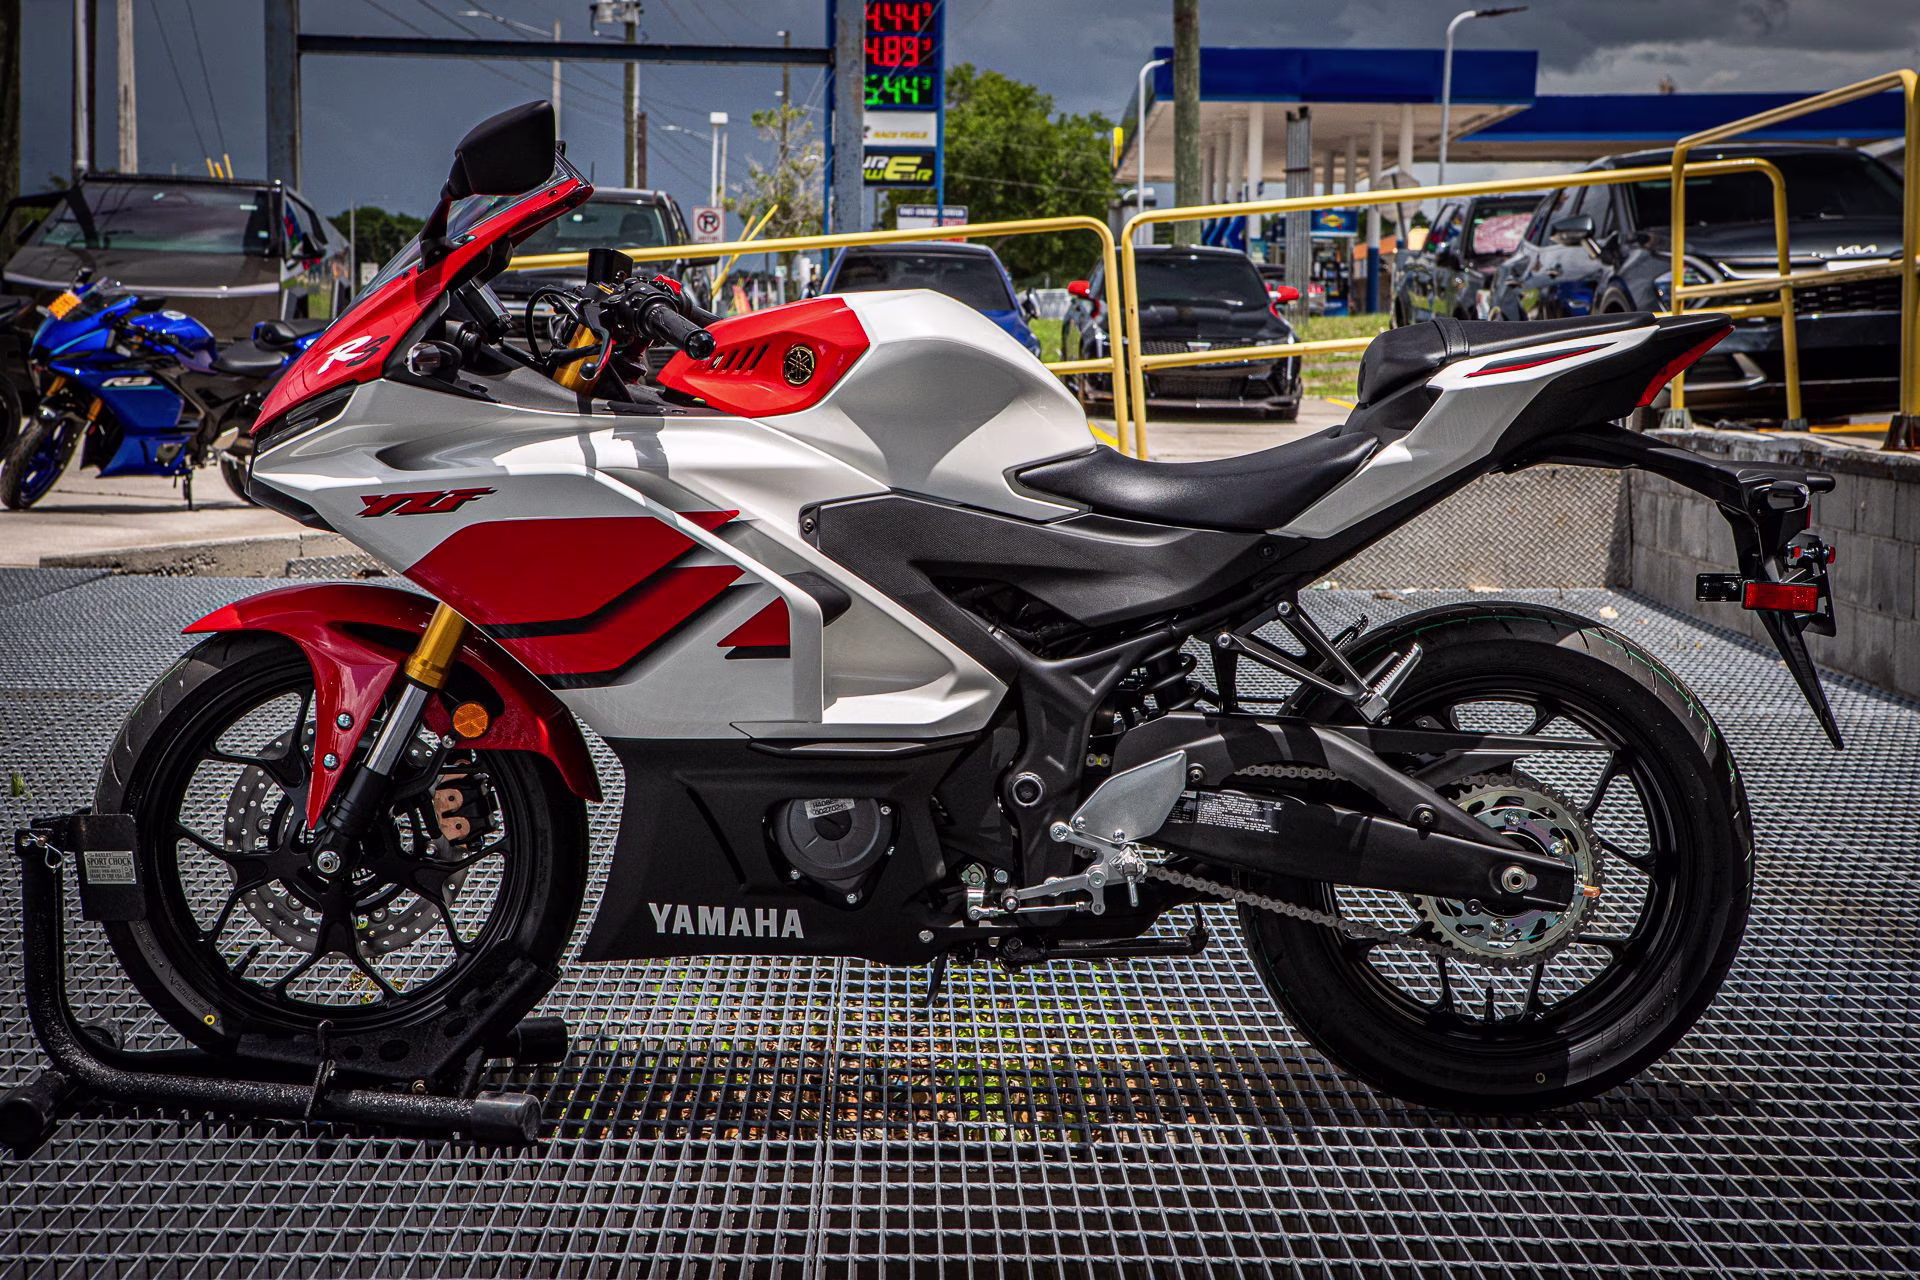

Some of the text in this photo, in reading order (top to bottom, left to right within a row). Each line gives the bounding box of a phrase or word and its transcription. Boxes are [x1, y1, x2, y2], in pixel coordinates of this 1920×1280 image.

[86, 857, 132, 866] SPORT CHOCK
[648, 902, 805, 939] YAMAHA
